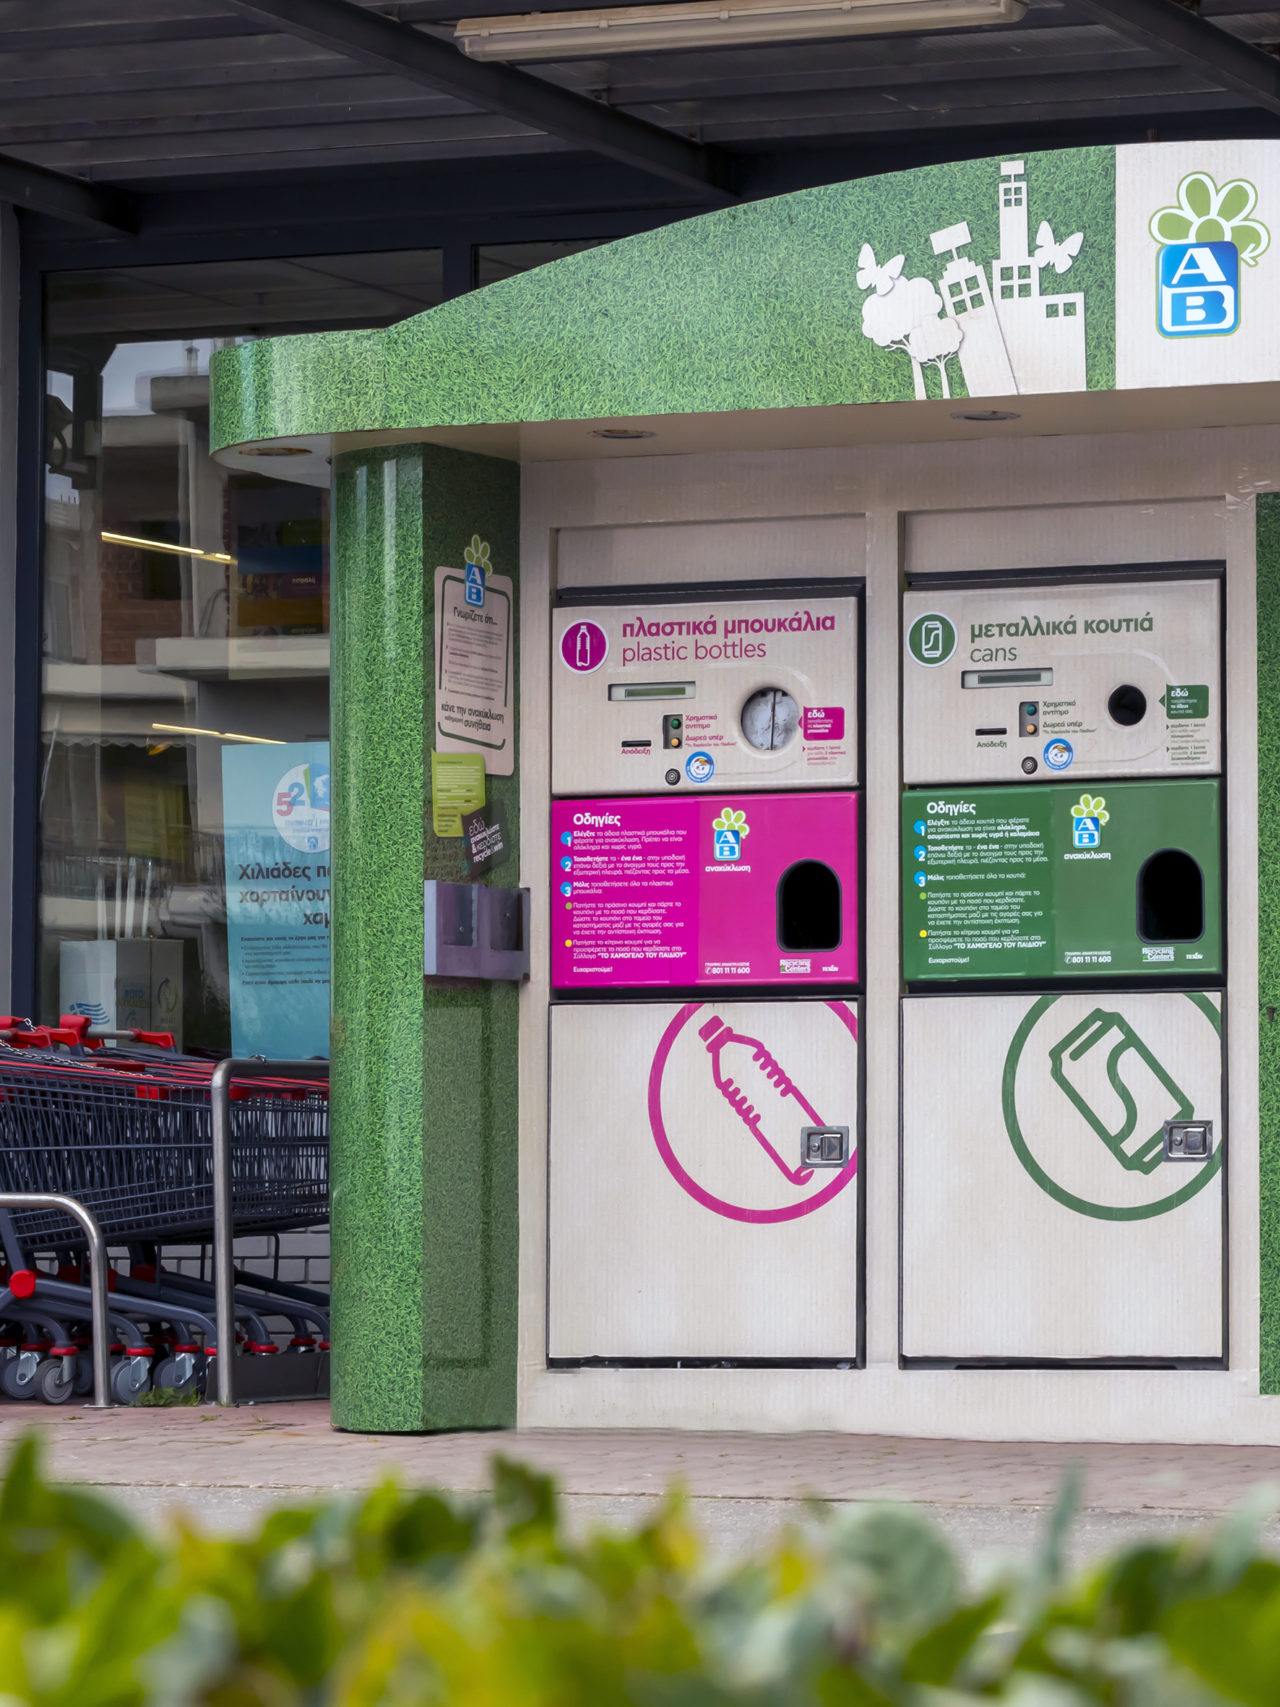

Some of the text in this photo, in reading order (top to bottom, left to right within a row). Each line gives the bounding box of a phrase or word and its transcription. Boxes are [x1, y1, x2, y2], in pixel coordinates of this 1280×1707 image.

[622, 610, 835, 639] πλαστικά μπουκάλια
[970, 611, 1154, 643] μεταλλικά κουτιά
[622, 639, 767, 667] plastic bottles
[970, 646, 1018, 662] cans
[1170, 687, 1189, 698] εδώ
[807, 709, 825, 719] εδώ
[976, 741, 1007, 749] Απόδειξη
[927, 801, 976, 816] Οδηγίες
[573, 812, 621, 828] Οδηγίες
[239, 861, 311, 882] Χιλιάδες
[1098, 955, 1111, 963] 600
